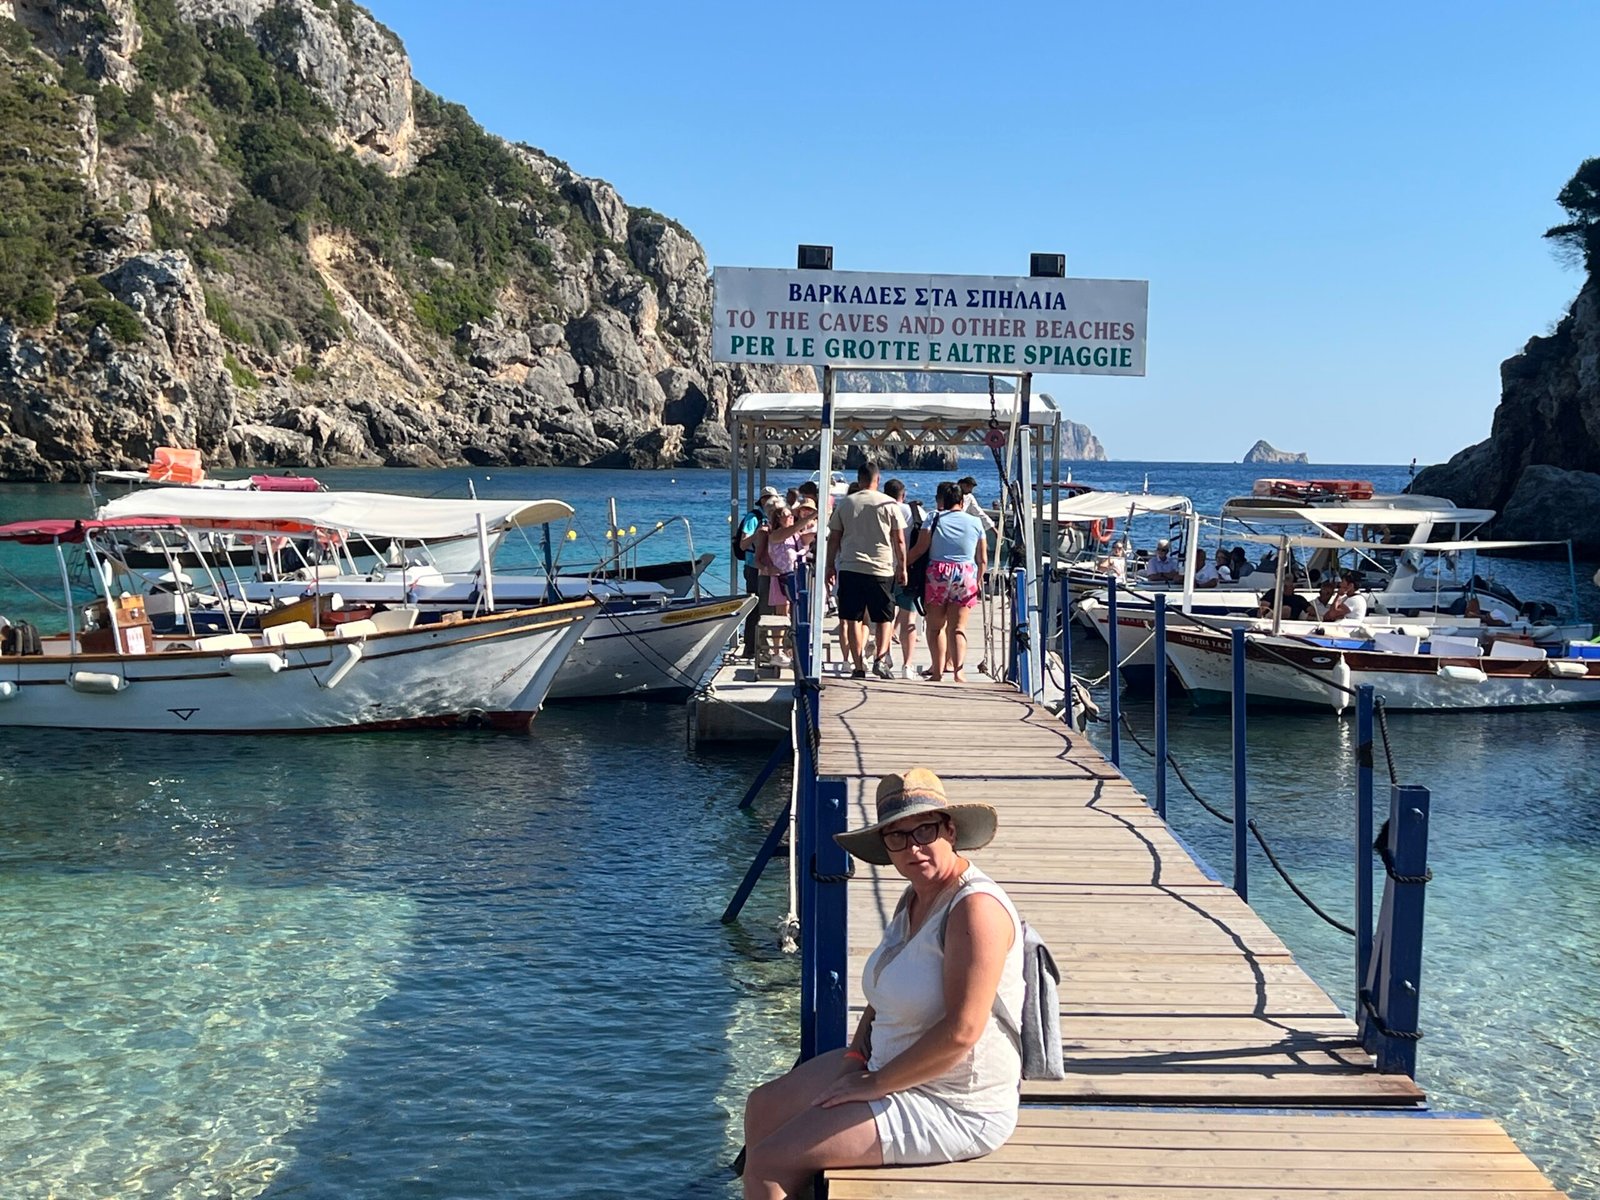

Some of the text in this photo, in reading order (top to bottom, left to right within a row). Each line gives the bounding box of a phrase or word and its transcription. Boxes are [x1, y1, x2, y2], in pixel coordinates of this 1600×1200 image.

[789, 283, 1067, 310] ΒΑΡΚΑΔΕΣ ΣΤΑ ΣΠΗΛΑΙΑ
[726, 309, 1135, 341] TO THE CAVES AND OTHER BEACHES
[730, 335, 1132, 367] PER LE GROTTE E ALTRE SPIAGGIE
